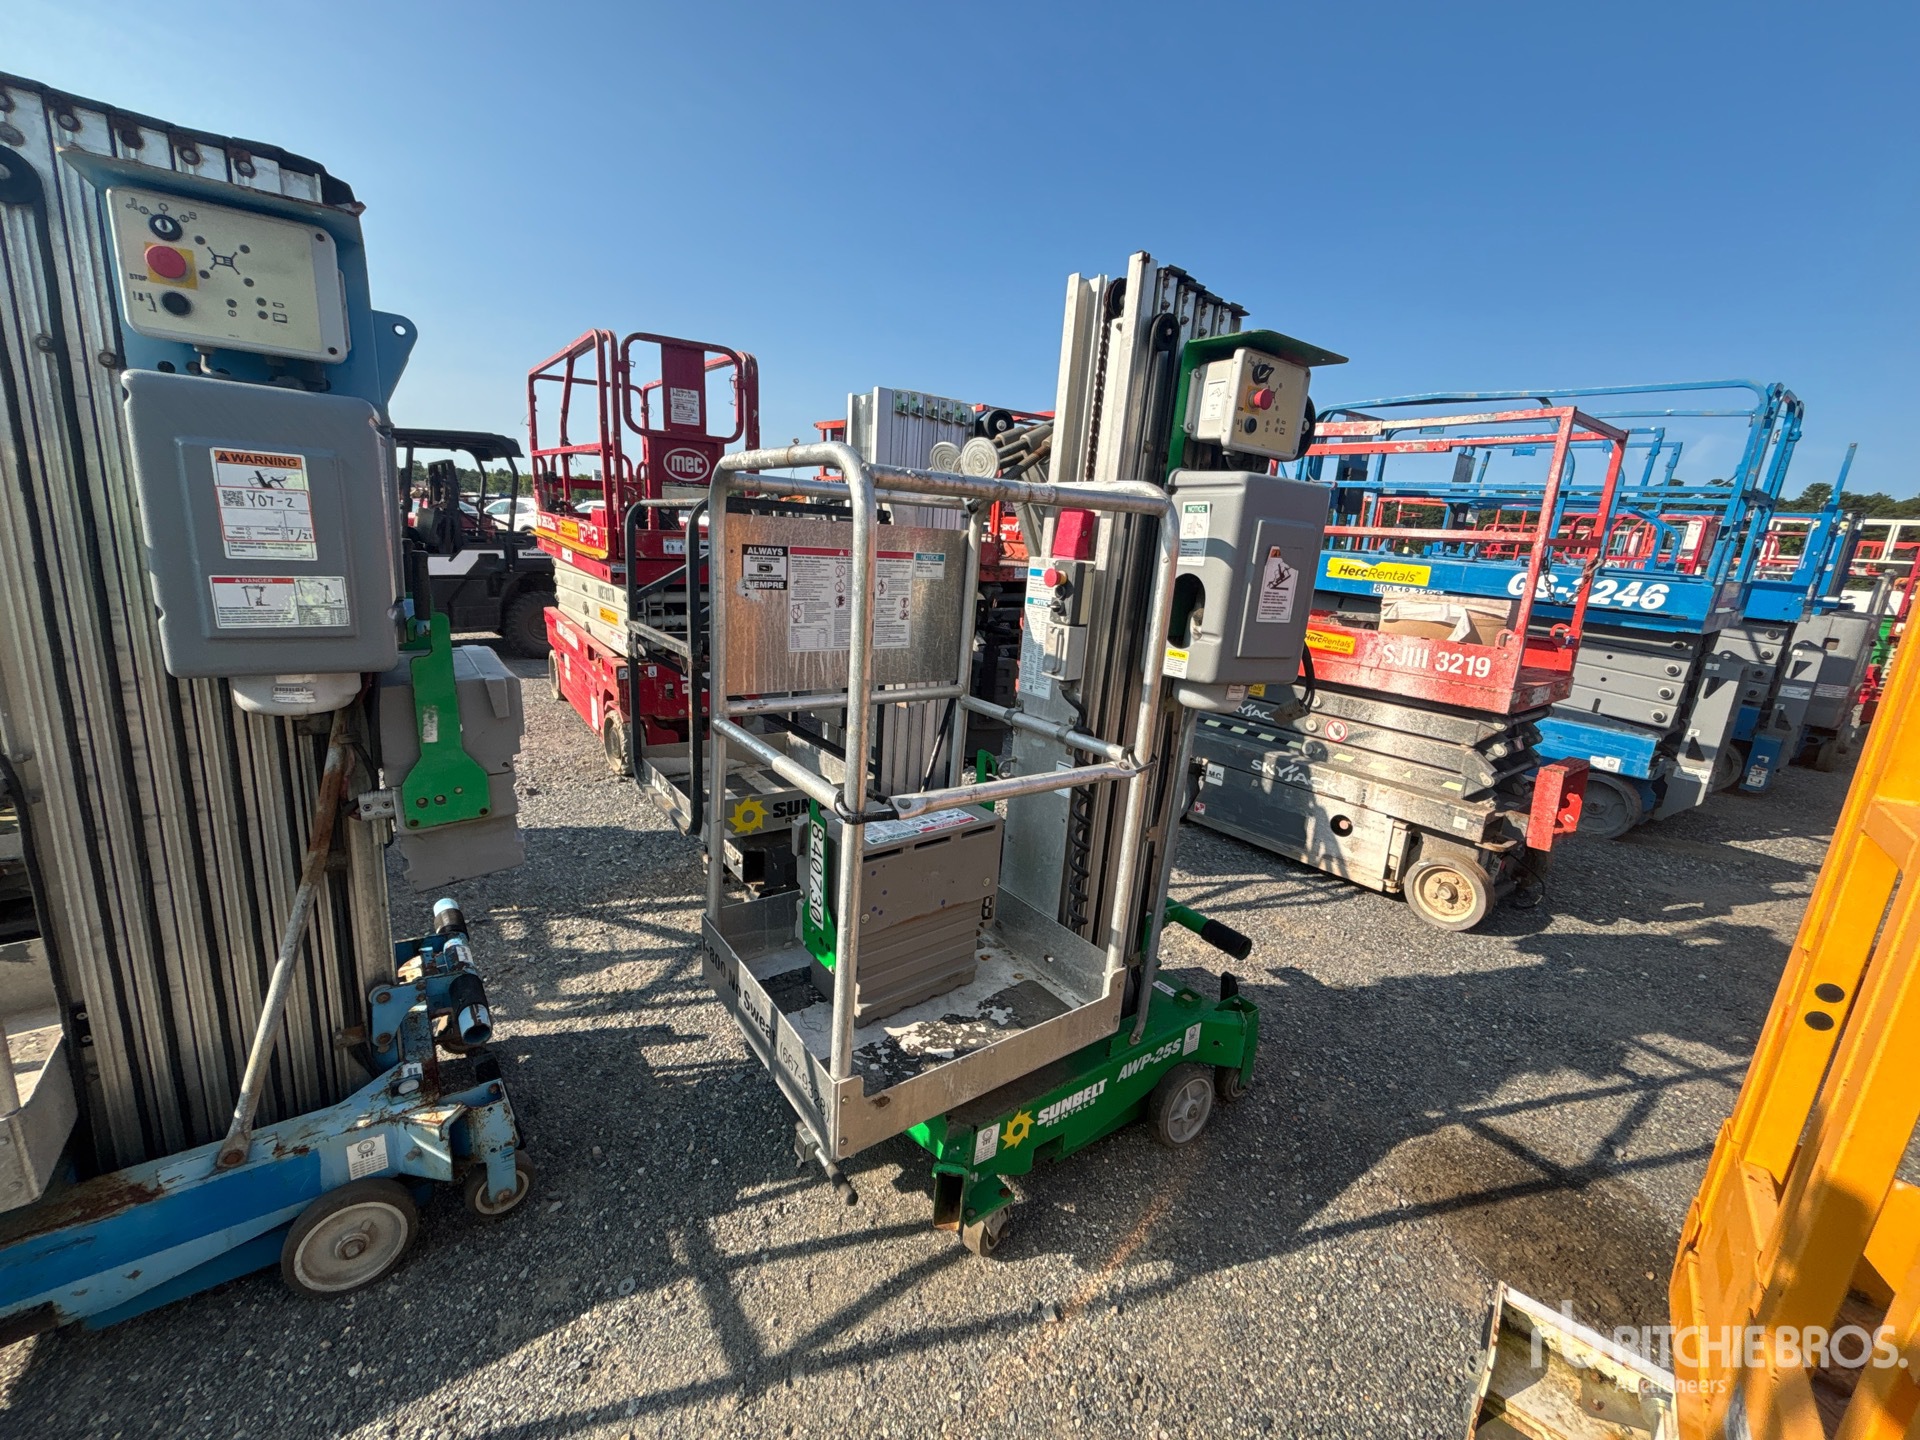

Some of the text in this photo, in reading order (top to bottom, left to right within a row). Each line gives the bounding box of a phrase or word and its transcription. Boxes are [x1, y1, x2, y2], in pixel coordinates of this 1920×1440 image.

[129, 273, 148, 282] STOP
[230, 453, 297, 467] WARNING
[1187, 504, 1206, 513] NOTICE
[747, 546, 784, 556] ALWAYS
[1338, 564, 1416, 582] HercRentals
[745, 581, 784, 589] SIEMPRE
[1435, 651, 1491, 678] 3219
[1251, 759, 1337, 793] SKYJACK
[702, 936, 830, 1123] 1-800 No Sweat (667-9328)
[1116, 1037, 1182, 1083] AWP-25S
[1036, 1078, 1108, 1126] SUNBELT
[1045, 1099, 1096, 1128] RENTALS
